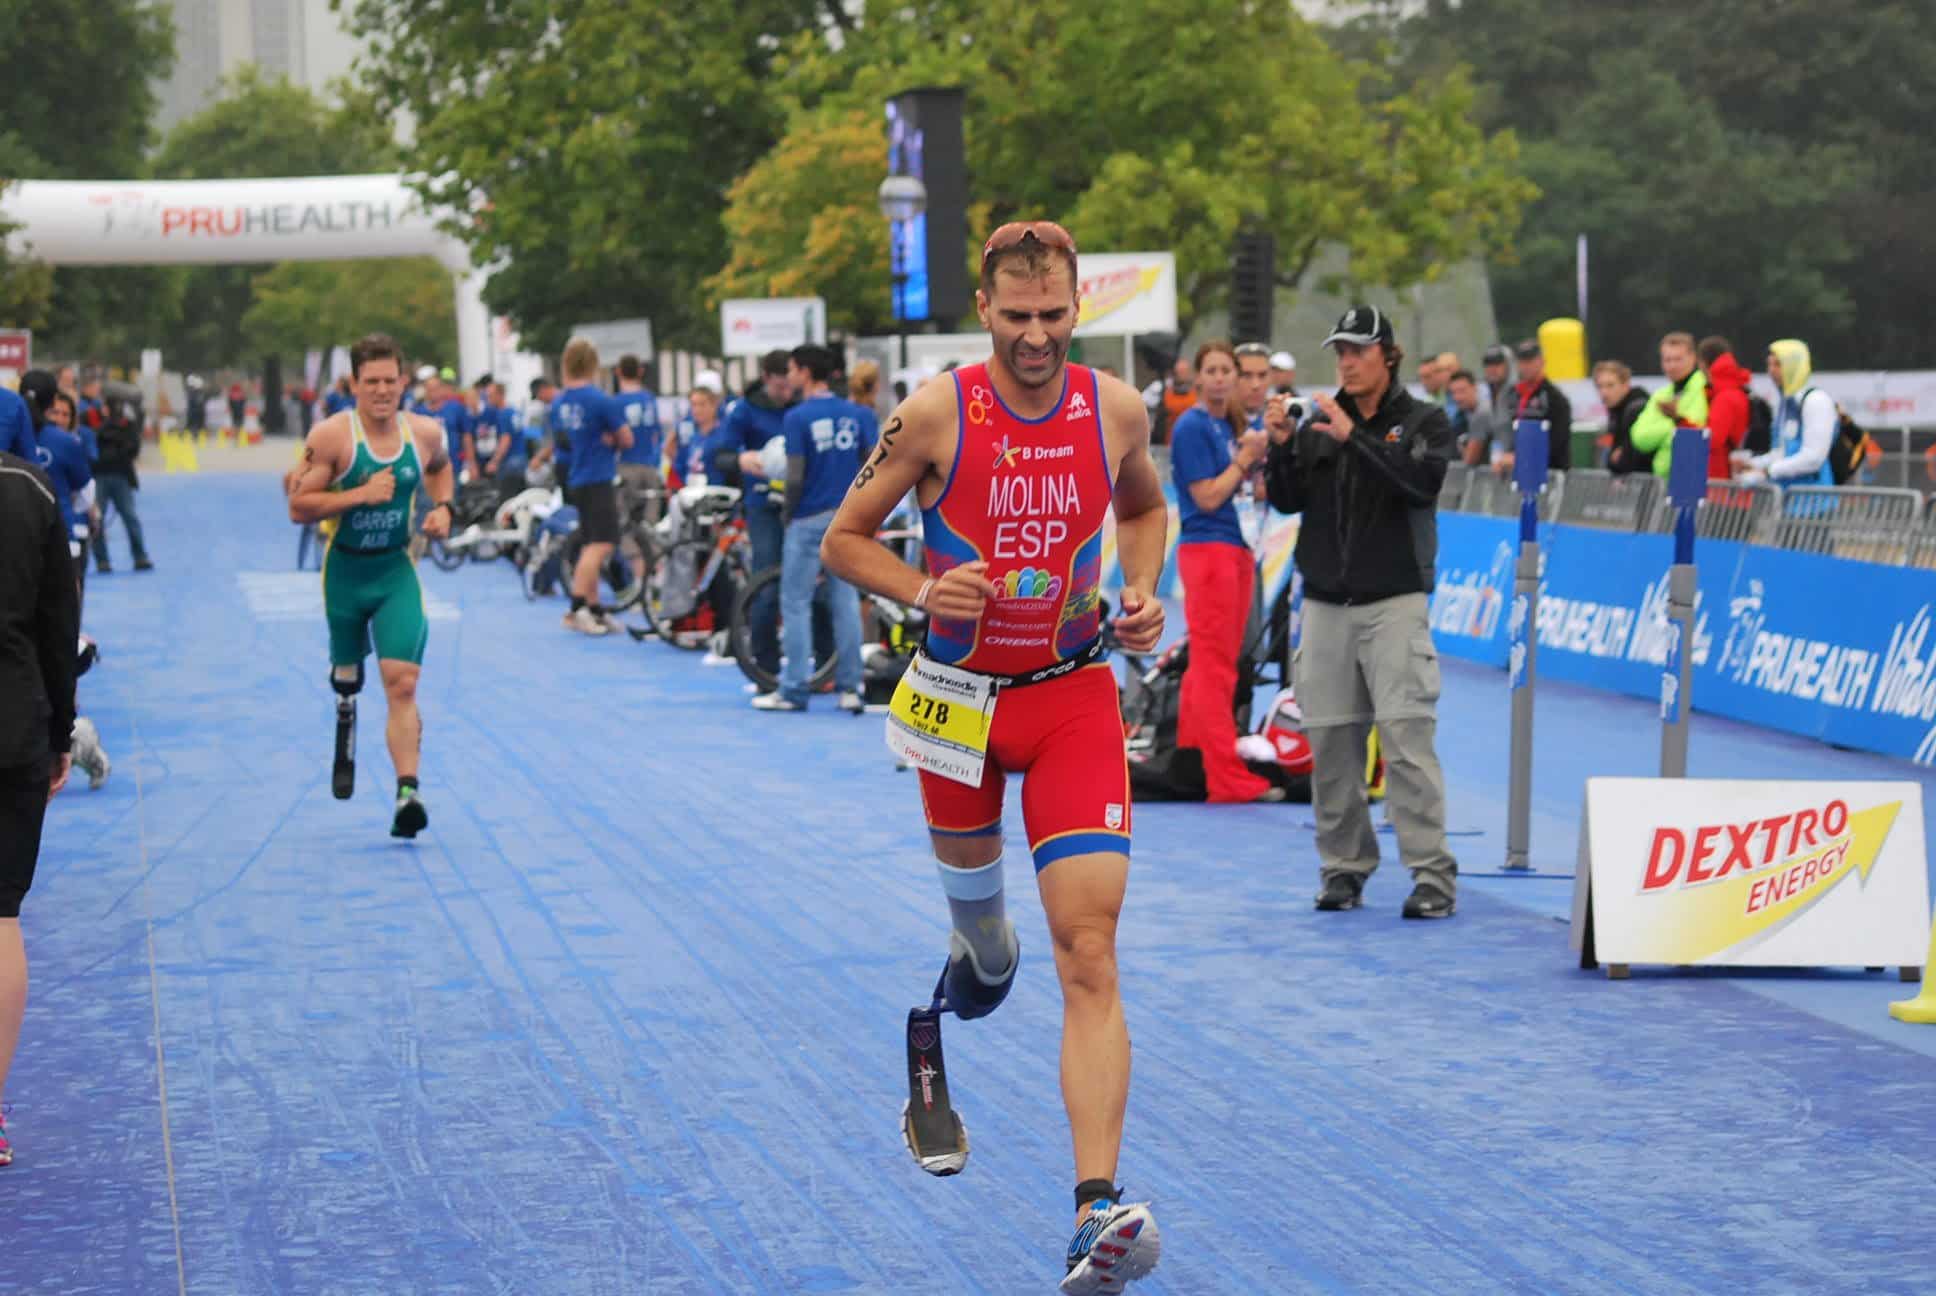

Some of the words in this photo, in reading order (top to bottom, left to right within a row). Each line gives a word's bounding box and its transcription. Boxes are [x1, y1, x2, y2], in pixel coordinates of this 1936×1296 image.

[161, 202, 391, 237] PRUHEALTH
[1022, 447, 1032, 460] B
[1034, 445, 1074, 460] Dream
[987, 473, 1081, 518] MOLINA
[351, 510, 403, 530] GARVEY
[994, 520, 1068, 558] ESP
[985, 636, 1049, 646] ORBEA
[1536, 596, 1635, 660] PRUHEALTH
[1031, 660, 1076, 681] orca
[1744, 630, 1880, 711] PRUHEALTH
[910, 692, 949, 725] 278
[1642, 799, 1848, 890] DEXTRO
[1746, 840, 1850, 914] ENERGY
